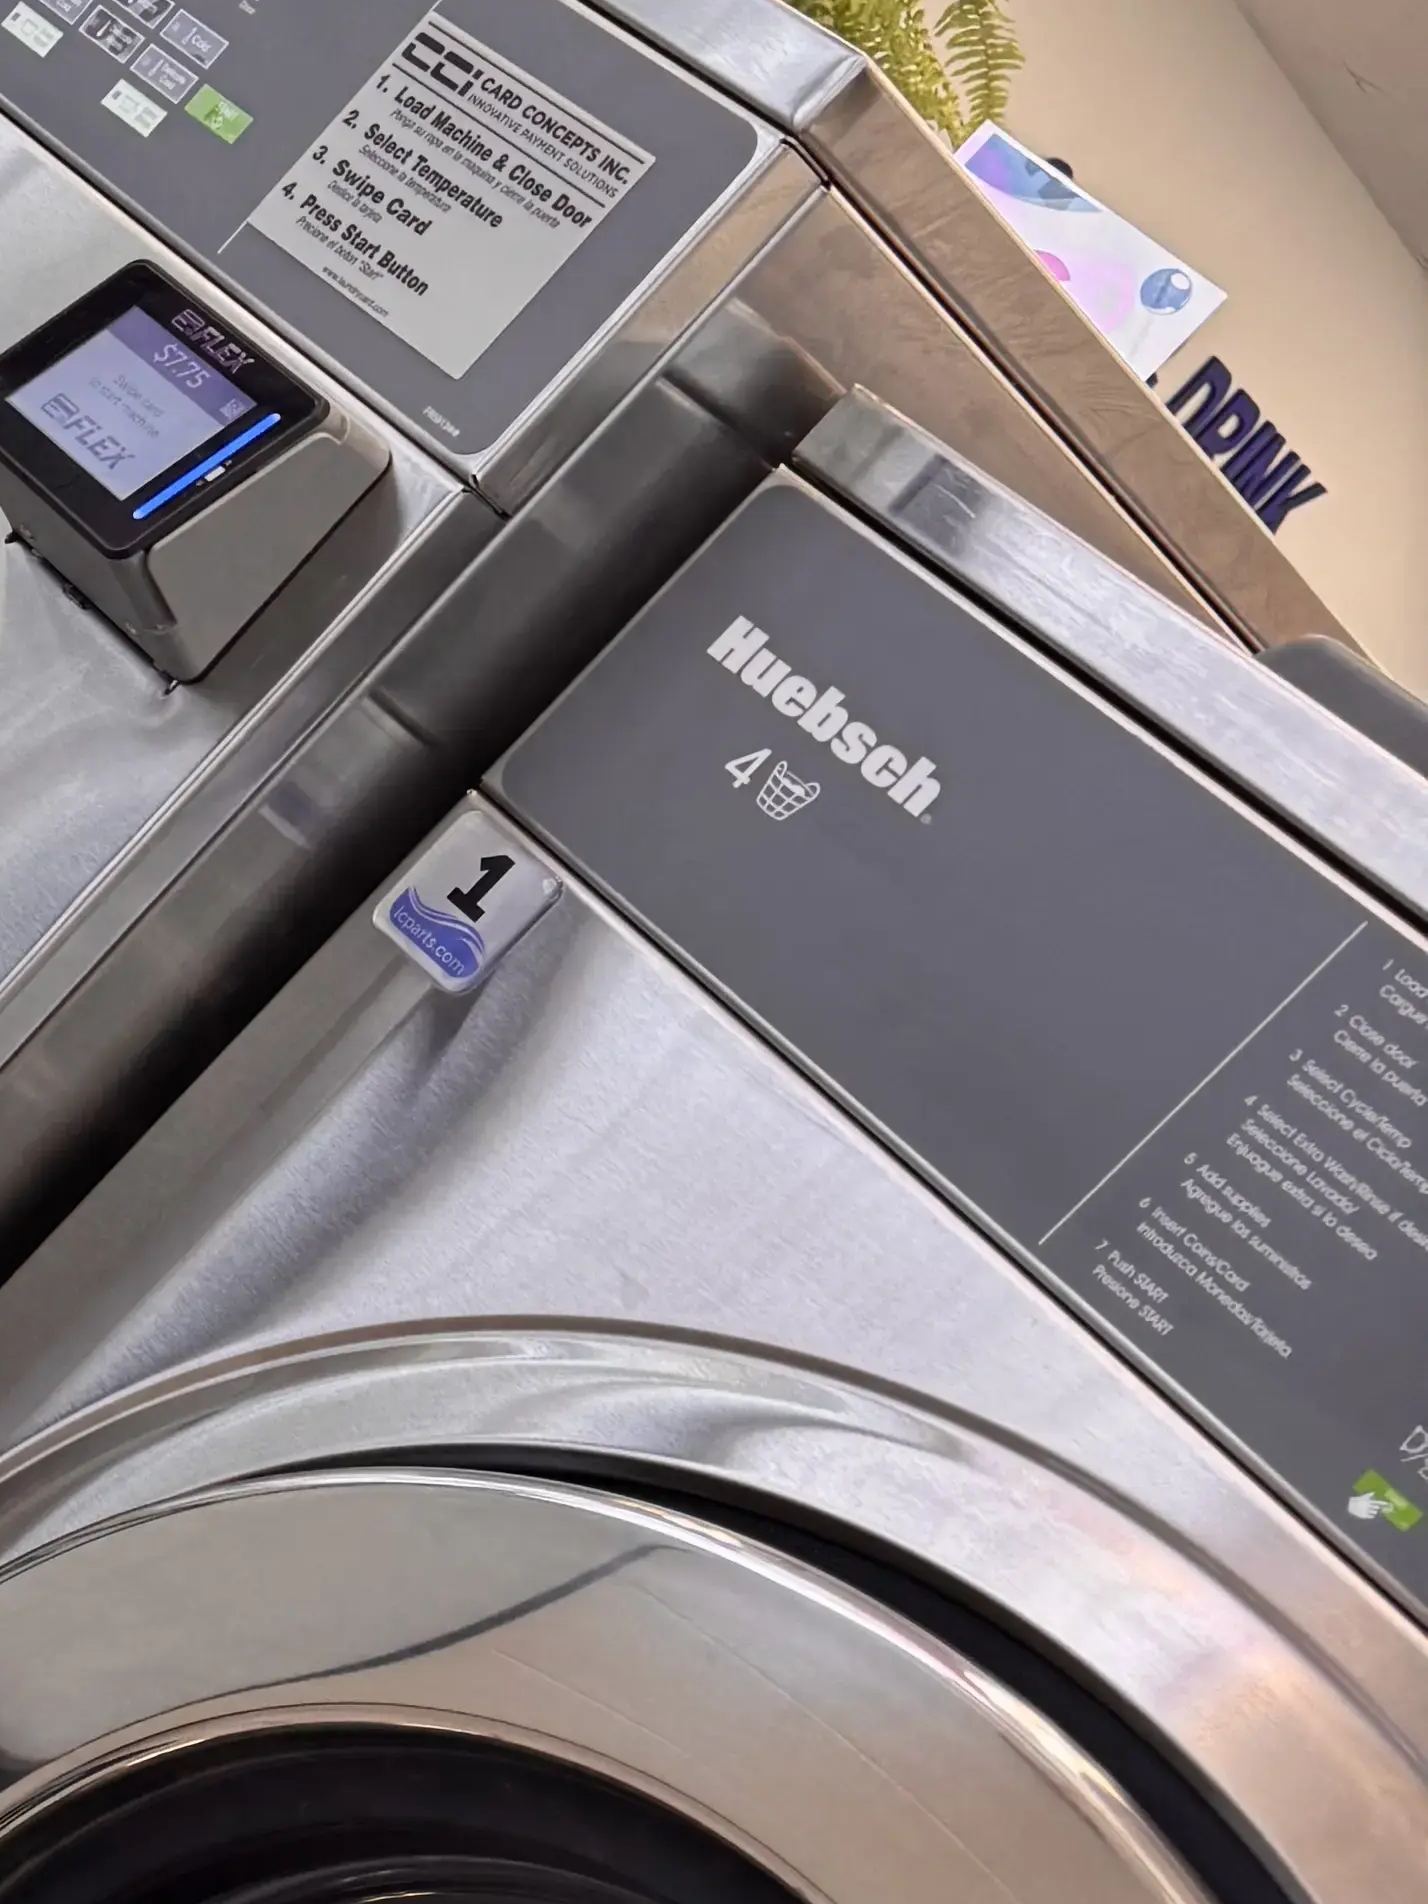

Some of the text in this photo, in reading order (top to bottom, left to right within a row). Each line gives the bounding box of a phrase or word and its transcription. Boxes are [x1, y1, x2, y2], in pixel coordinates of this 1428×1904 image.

[374, 73, 595, 229] 1. Load Machine & Close Door
[465, 92, 618, 199] INNOVATIVE PAYMENT SOLUTIONS
[478, 76, 634, 184] CARD CONCEPTS INC.
[309, 145, 433, 236] 3. Swipe Card
[341, 108, 507, 232] 2. Select Temperature
[279, 180, 432, 296] 4. Press Start Button
[151, 342, 211, 390] $7.75
[192, 325, 255, 375] FLEX
[64, 411, 134, 471] FLEX
[706, 614, 945, 819] Huebsch
[724, 749, 772, 788] 4
[447, 854, 516, 923] 1
[1288, 1047, 1304, 1061] 3
[1301, 1057, 1344, 1094] Select
[1333, 1003, 1417, 1070] 2 Close door
[1242, 1092, 1258, 1106] 4
[1256, 1103, 1298, 1138] Select
[1285, 1073, 1370, 1142] Seleccione el
[1240, 1117, 1310, 1176] Seleccione
[1137, 1195, 1153, 1208] 6
[1150, 1206, 1187, 1238] Insert
[1183, 1151, 1273, 1230] 5 Add supplies
[1279, 1178, 1316, 1209] extra
[1310, 1203, 1326, 1217] si
[1320, 1212, 1339, 1228] lo
[1333, 1223, 1379, 1262] desea
[1092, 1263, 1173, 1336] Presione START
[1094, 1239, 1168, 1304] 7 Push START
